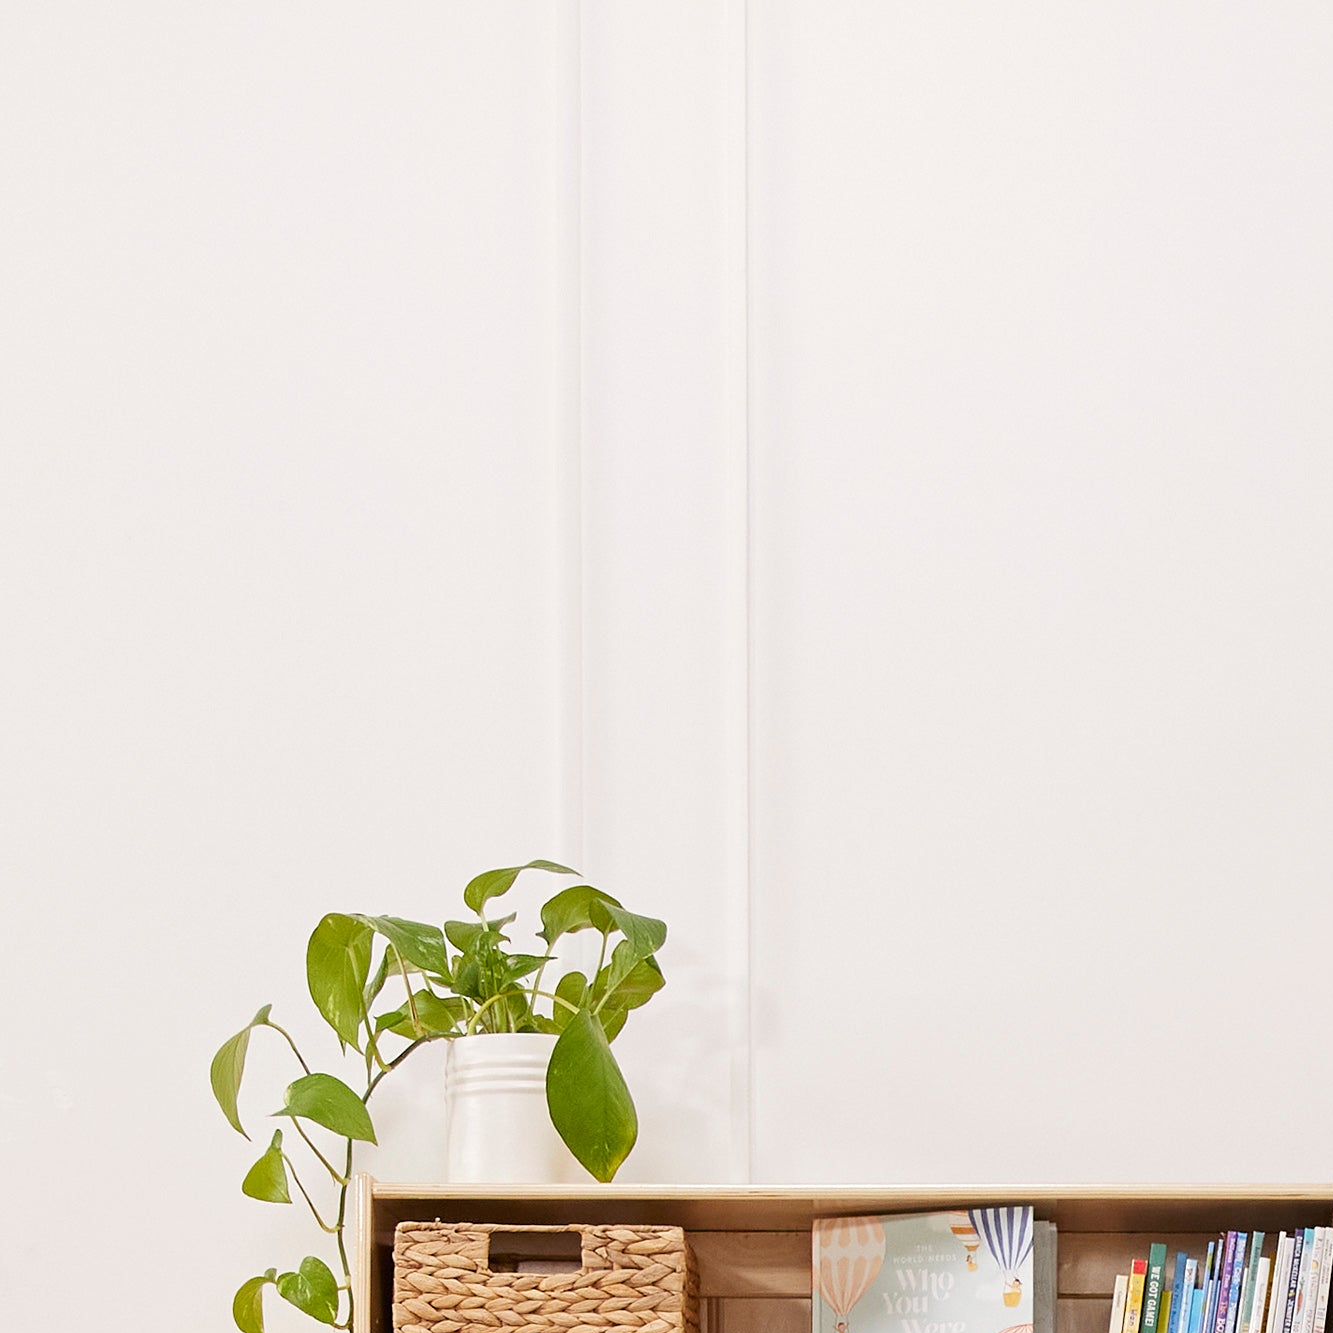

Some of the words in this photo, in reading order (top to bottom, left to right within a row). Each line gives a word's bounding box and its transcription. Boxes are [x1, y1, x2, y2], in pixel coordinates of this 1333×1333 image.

[1149, 1265, 1160, 1279] WE
[895, 1268, 955, 1300] Who
[1147, 1280, 1159, 1298] GOT
[882, 1292, 928, 1314] You
[1144, 1298, 1156, 1327] GAME!
